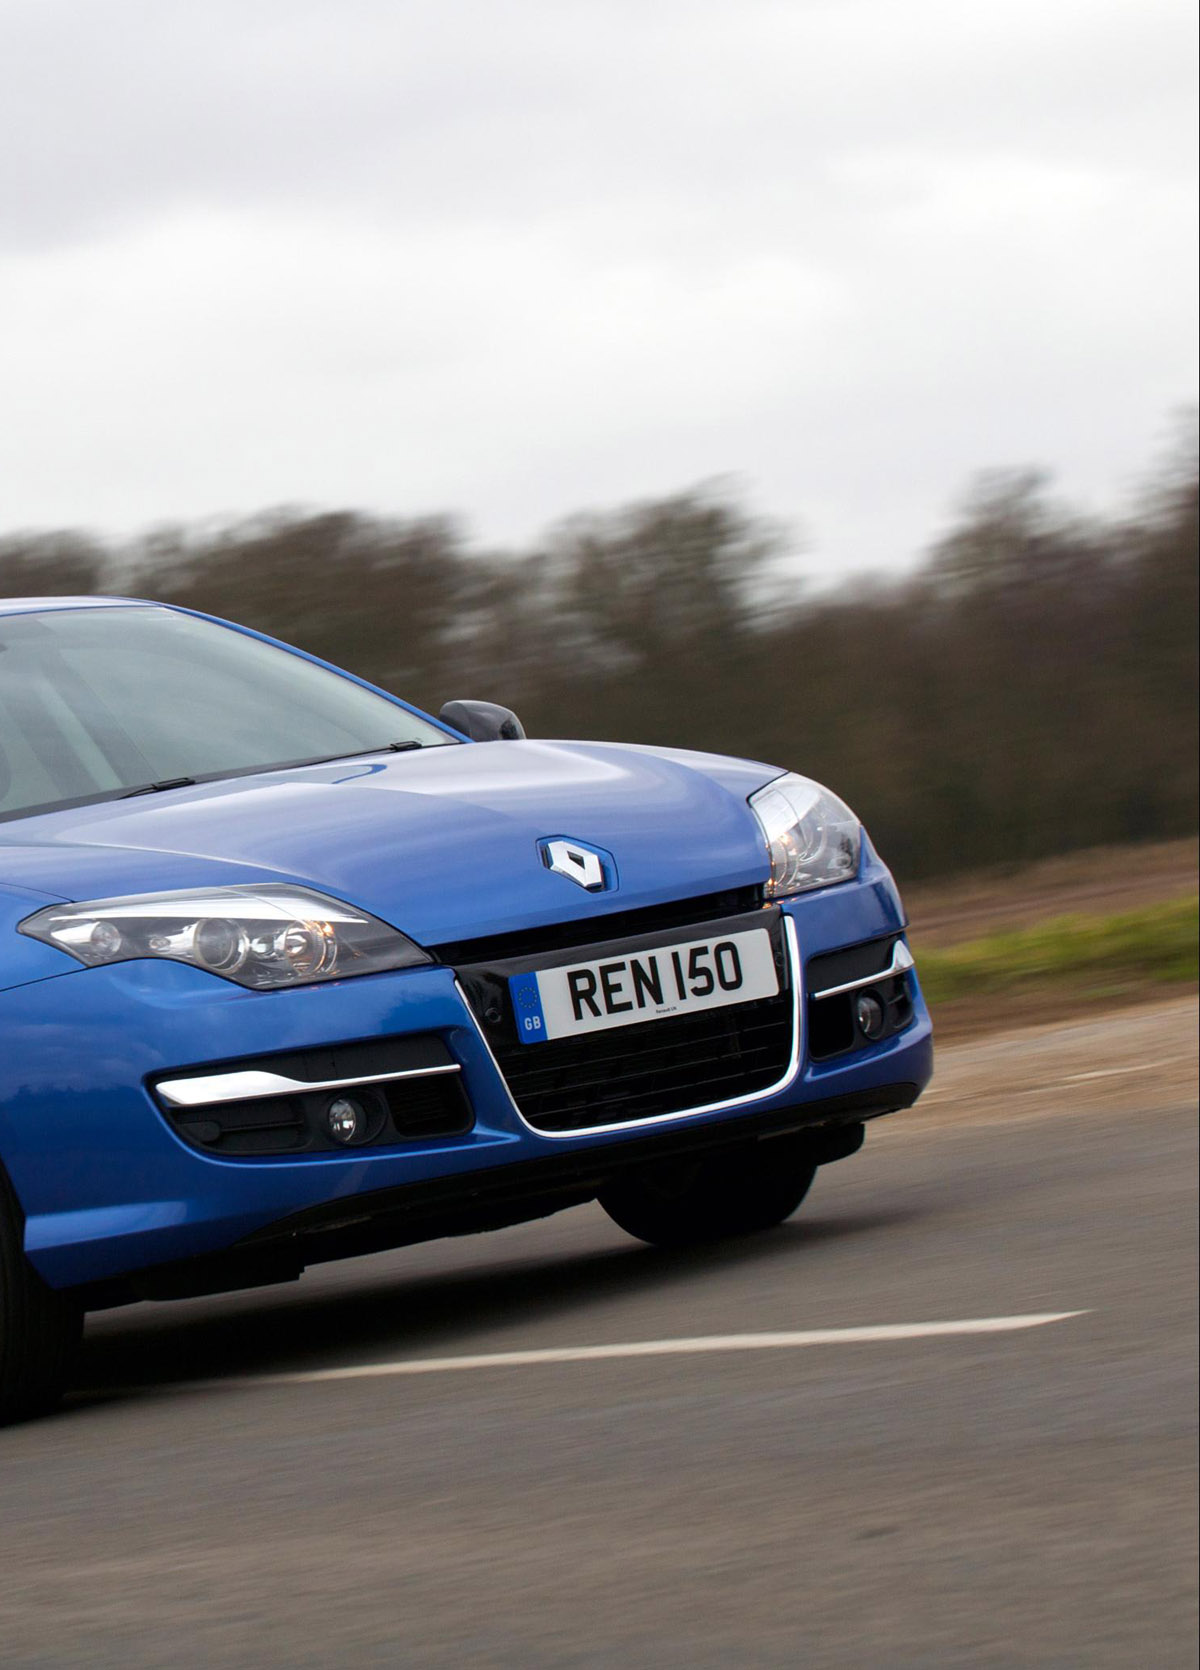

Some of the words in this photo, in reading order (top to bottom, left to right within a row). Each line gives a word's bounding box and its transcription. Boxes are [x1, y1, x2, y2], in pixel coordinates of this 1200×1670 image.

[566, 955, 665, 1021] REN
[671, 941, 743, 1001] 150
[524, 1016, 542, 1030] GB
